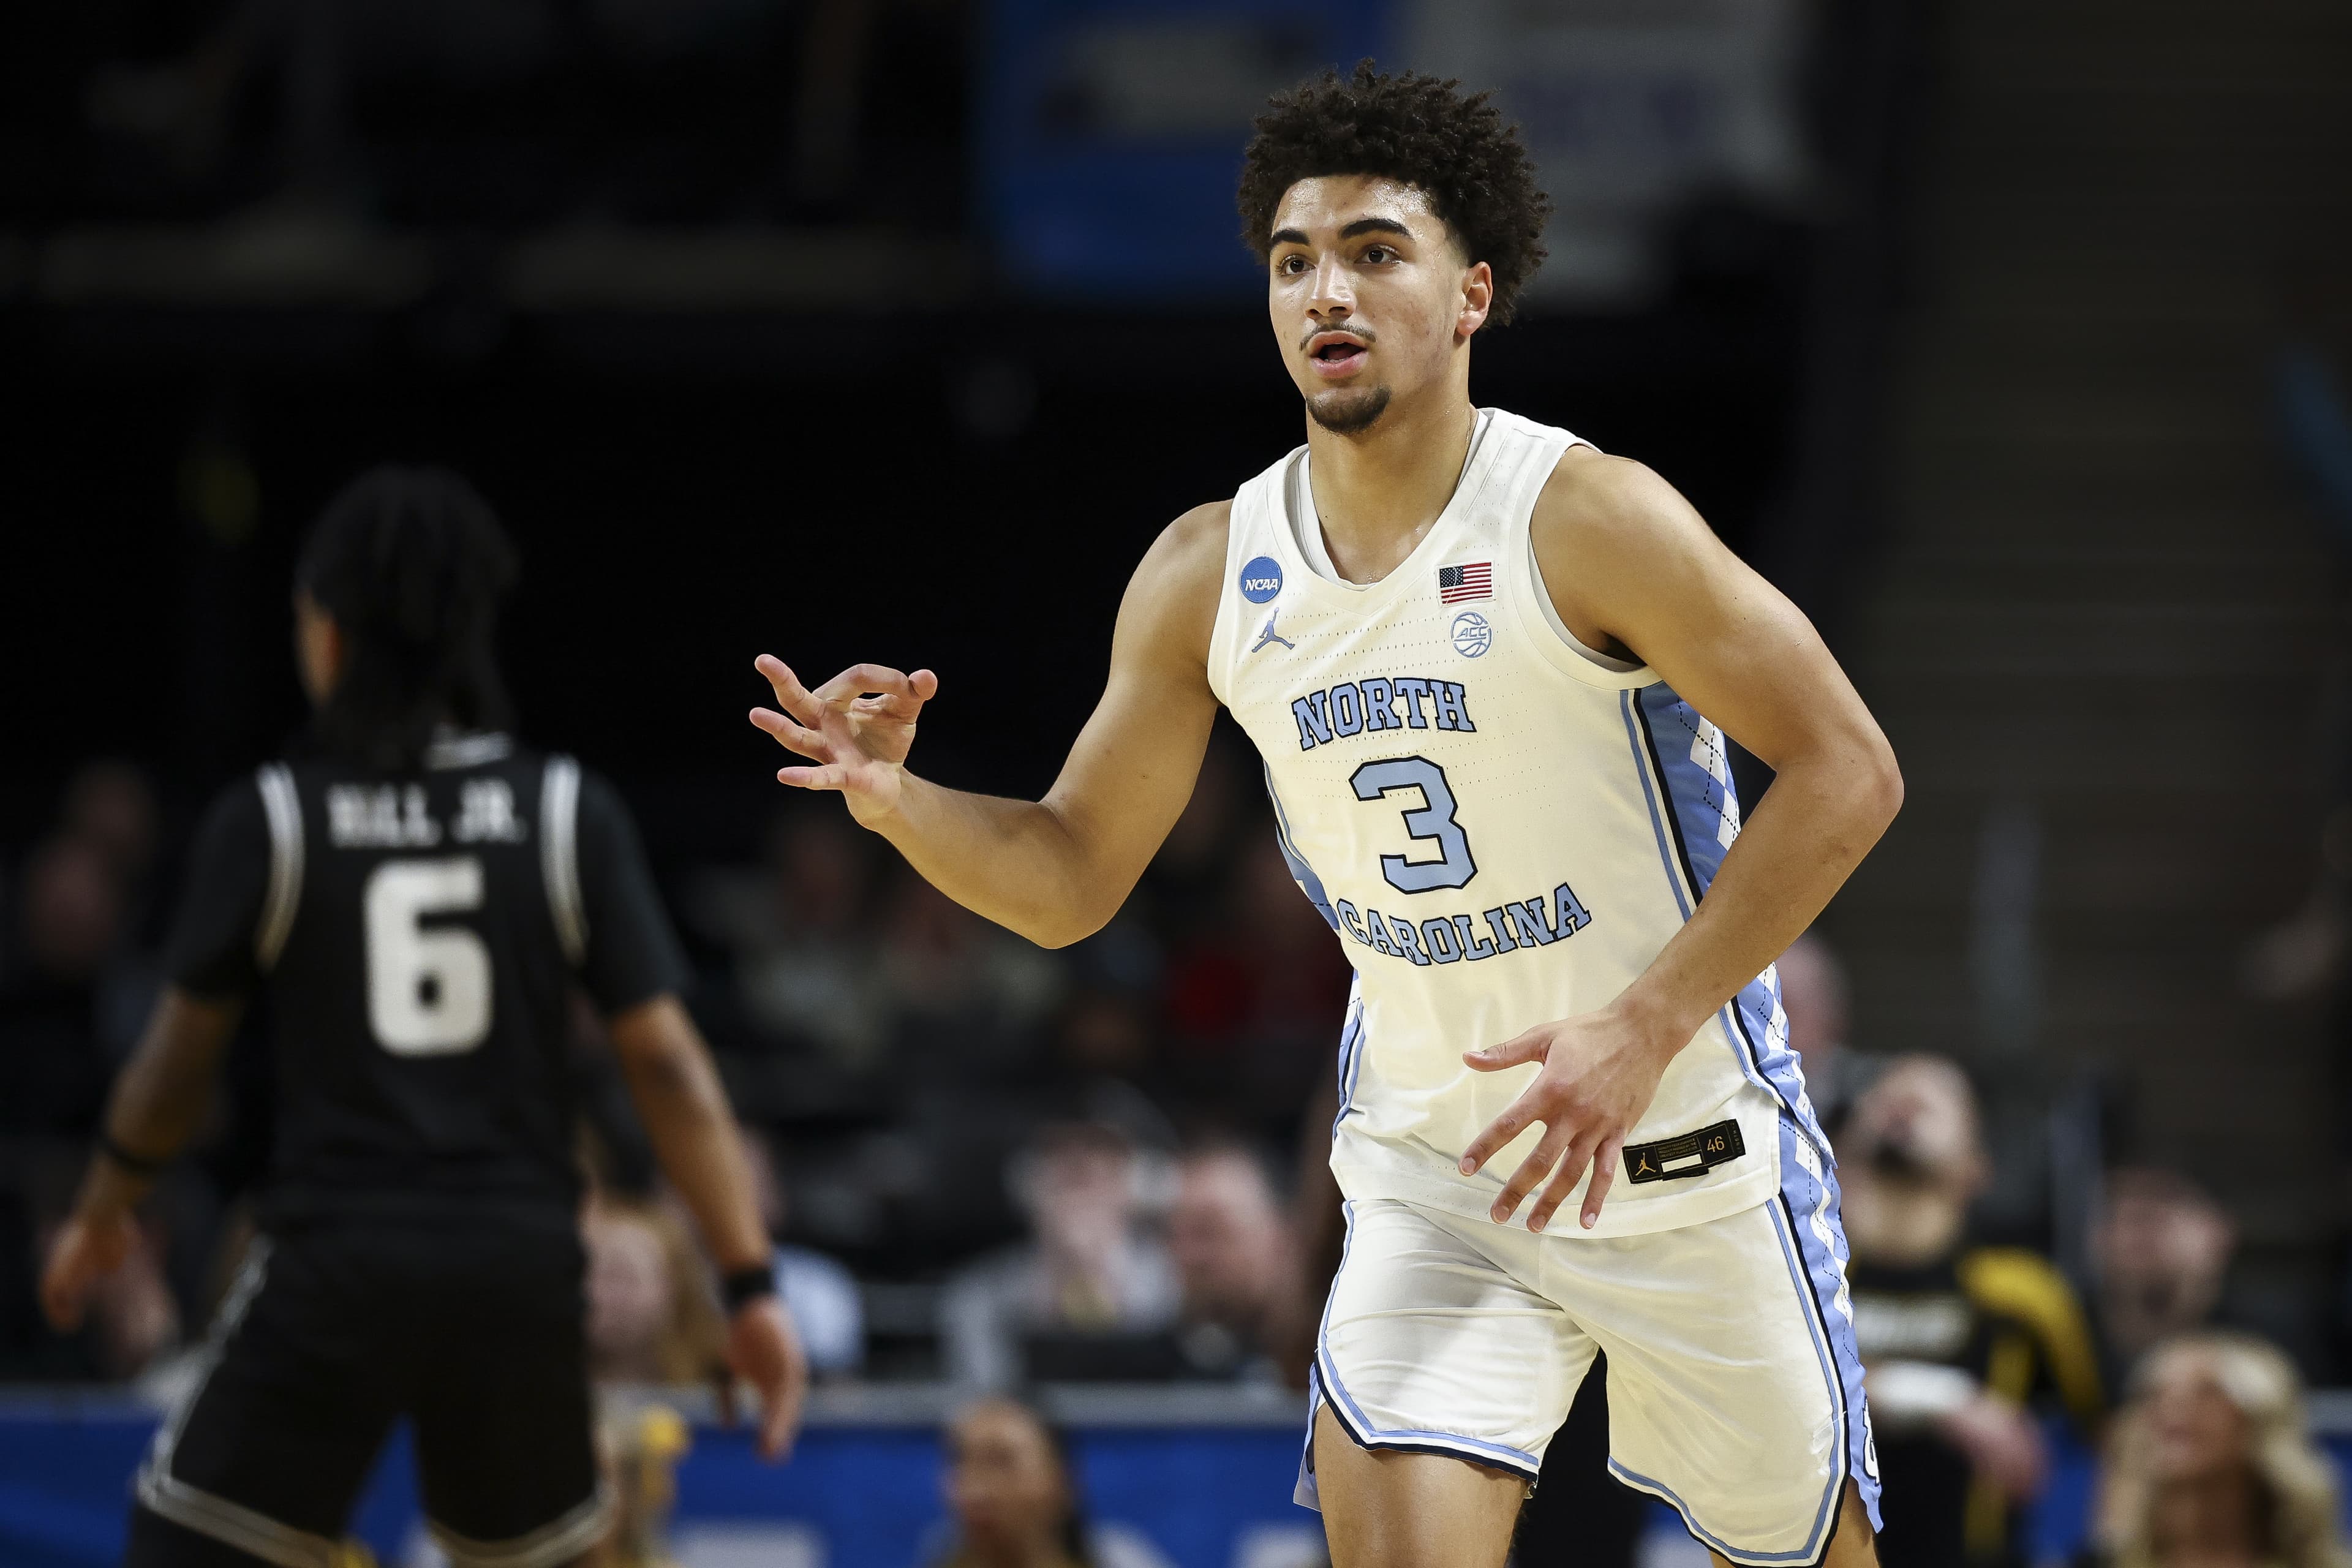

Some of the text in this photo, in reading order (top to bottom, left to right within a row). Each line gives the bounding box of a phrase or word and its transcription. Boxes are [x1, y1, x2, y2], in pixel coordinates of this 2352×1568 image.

[1245, 578, 1279, 592] NCAA
[1459, 626, 1488, 639] ACC
[1292, 677, 1477, 751] NORTH
[1349, 755, 1477, 894] 3
[363, 858, 494, 1058] 6
[1336, 883, 1592, 966] CAROLINA
[1707, 1136, 1725, 1152] 46
